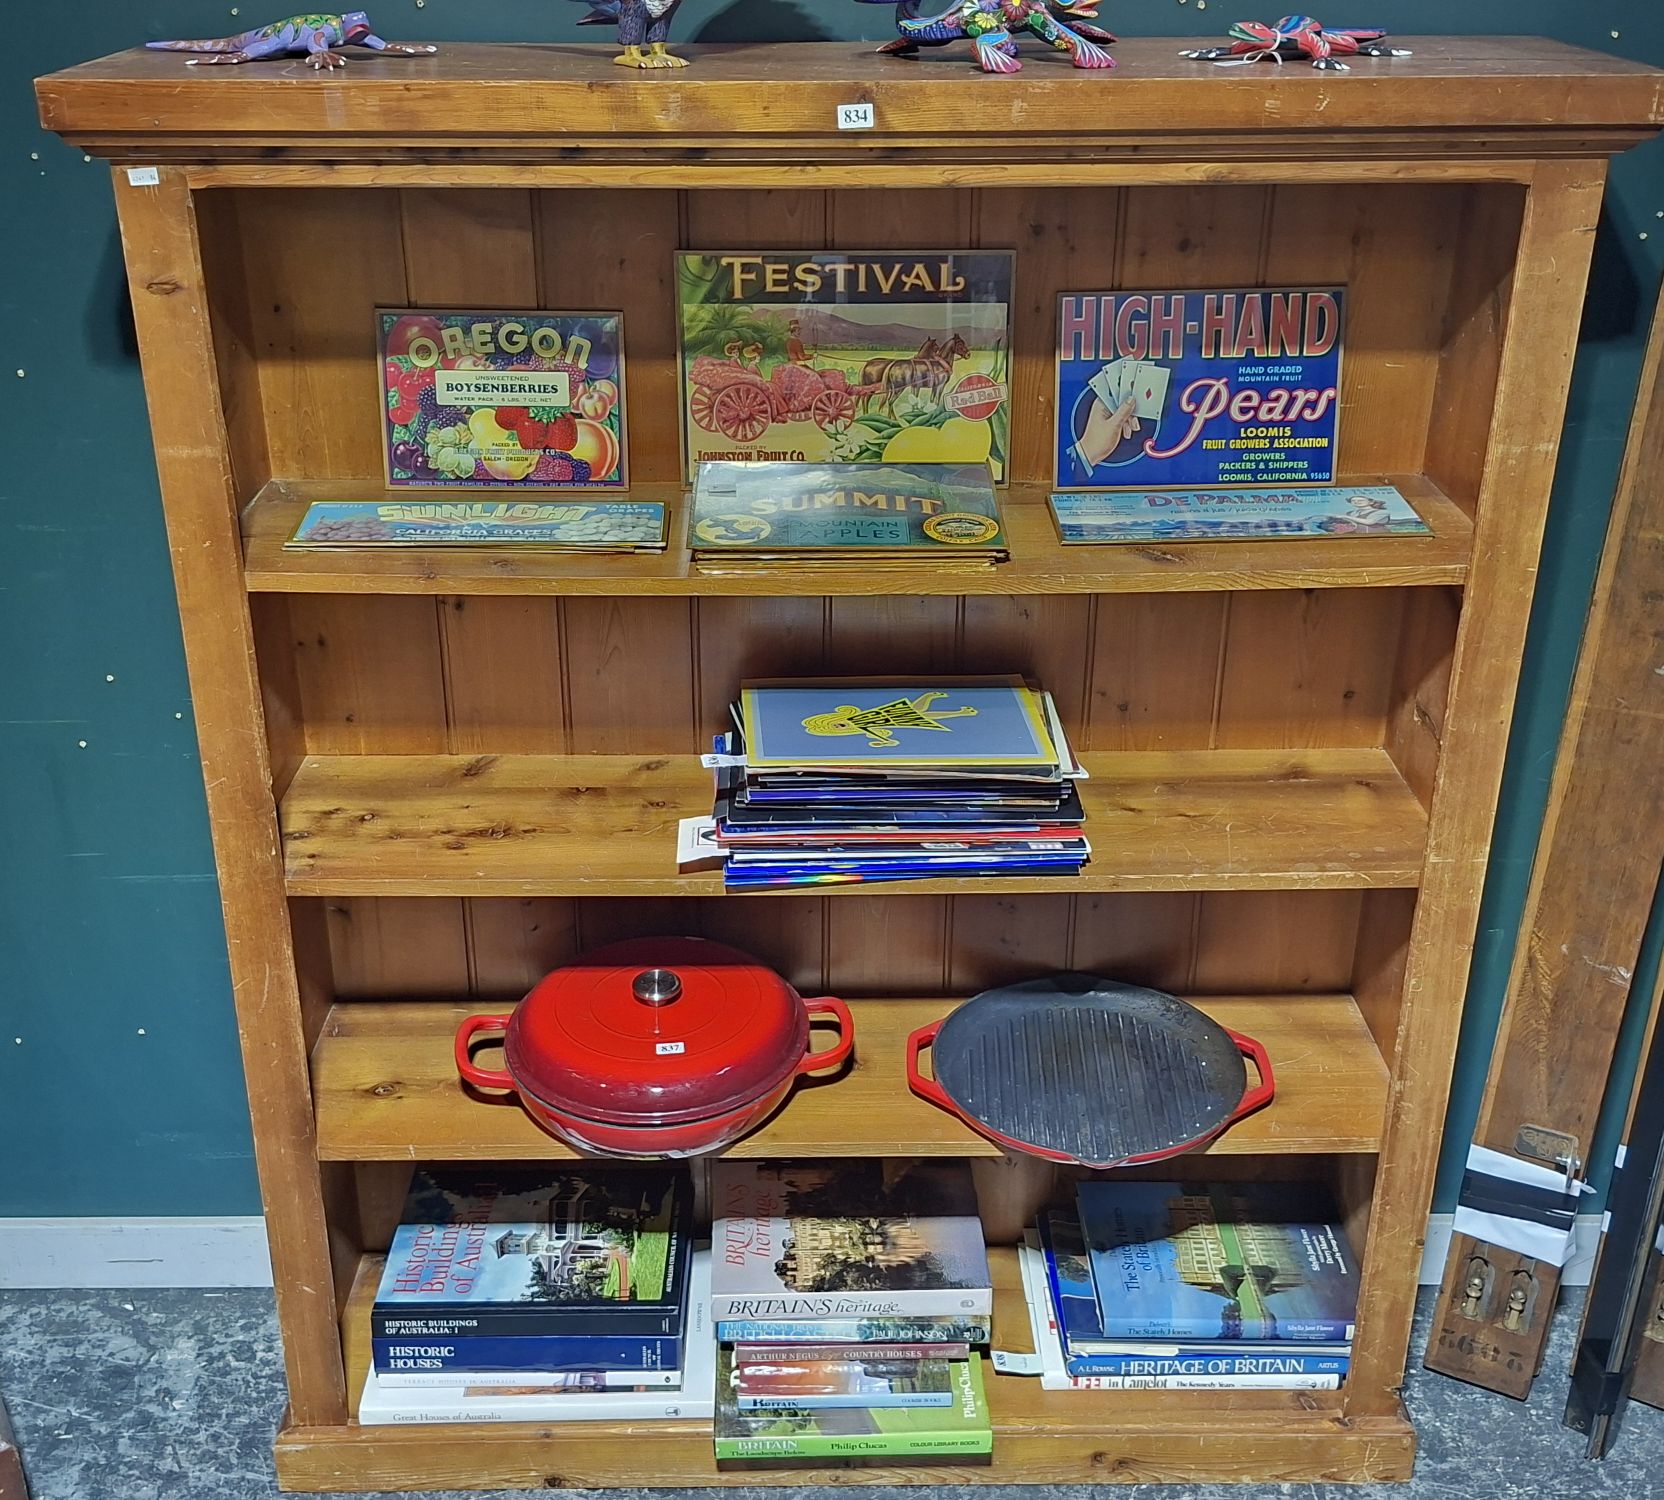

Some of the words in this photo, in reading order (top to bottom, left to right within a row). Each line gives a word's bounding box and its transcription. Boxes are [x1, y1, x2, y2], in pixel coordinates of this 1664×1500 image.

[844, 108, 868, 124] 834
[721, 257, 966, 299] FESTIVAL
[1060, 293, 1340, 361] HIGH-HAND
[408, 322, 592, 370] OREGON
[1238, 366, 1265, 375] HAND
[1267, 365, 1303, 374] GRADED
[446, 382, 559, 394] BOYSENBERRIES
[1143, 376, 1338, 460] Pears
[1240, 426, 1292, 438] LOOMIS
[1202, 439, 1226, 450] FRUIT
[1229, 438, 1270, 449] GROWERS
[1273, 437, 1329, 448] ASSOCIATION
[695, 450, 752, 461] JOHNSTON
[756, 450, 788, 461] FRUIT
[1218, 462, 1256, 470] PACKERS
[1268, 461, 1308, 469] SHIPPERS
[1218, 473, 1255, 482] LOOMIS,
[1257, 472, 1308, 480] CALIFORNIA
[1310, 472, 1330, 480] 95650
[750, 490, 944, 516] SUMMIT
[377, 503, 598, 522] SUNLIGHT
[798, 519, 898, 528] MOUNTAIN
[395, 528, 488, 536] CALIFORNIA
[799, 529, 901, 539] APPLES
[661, 1045, 680, 1053] 837
[392, 1224, 434, 1294] Historic
[1135, 1261, 1153, 1272] of
[451, 1274, 474, 1294] of
[1123, 1273, 1141, 1292] The
[385, 1320, 427, 1328] HISTORIC
[428, 1319, 478, 1327] BUILDINGS
[725, 1321, 742, 1330] THE
[746, 1322, 789, 1330] NATIONAL
[872, 1329, 896, 1338] PAUL
[898, 1329, 948, 1340] JOHNSON
[1142, 1328, 1167, 1336] Stately
[388, 1346, 455, 1357] HISTORIC
[750, 1352, 787, 1360] ARTHUR
[789, 1352, 820, 1360] NEGUS
[843, 1351, 886, 1359] COUNTRY
[887, 1350, 923, 1358] HOUSES
[389, 1358, 443, 1369] HOUSES
[1120, 1360, 1206, 1375] HERITAGE
[1207, 1359, 1230, 1375] OF
[1234, 1358, 1305, 1374] BRITAIN
[1317, 1362, 1339, 1370] ARTUS
[959, 1362, 972, 1388] Cluca
[1108, 1377, 1119, 1389] in
[1121, 1376, 1168, 1390] Camelot
[1189, 1380, 1216, 1388] Kennedy
[961, 1387, 977, 1419] Philip
[393, 1413, 417, 1422] Great
[420, 1413, 451, 1421] Houses
[452, 1412, 462, 1421] of
[463, 1412, 502, 1421] Australia
[738, 1439, 798, 1451] BRITAIN
[831, 1443, 857, 1452] Philip
[858, 1442, 887, 1450] Clucas
